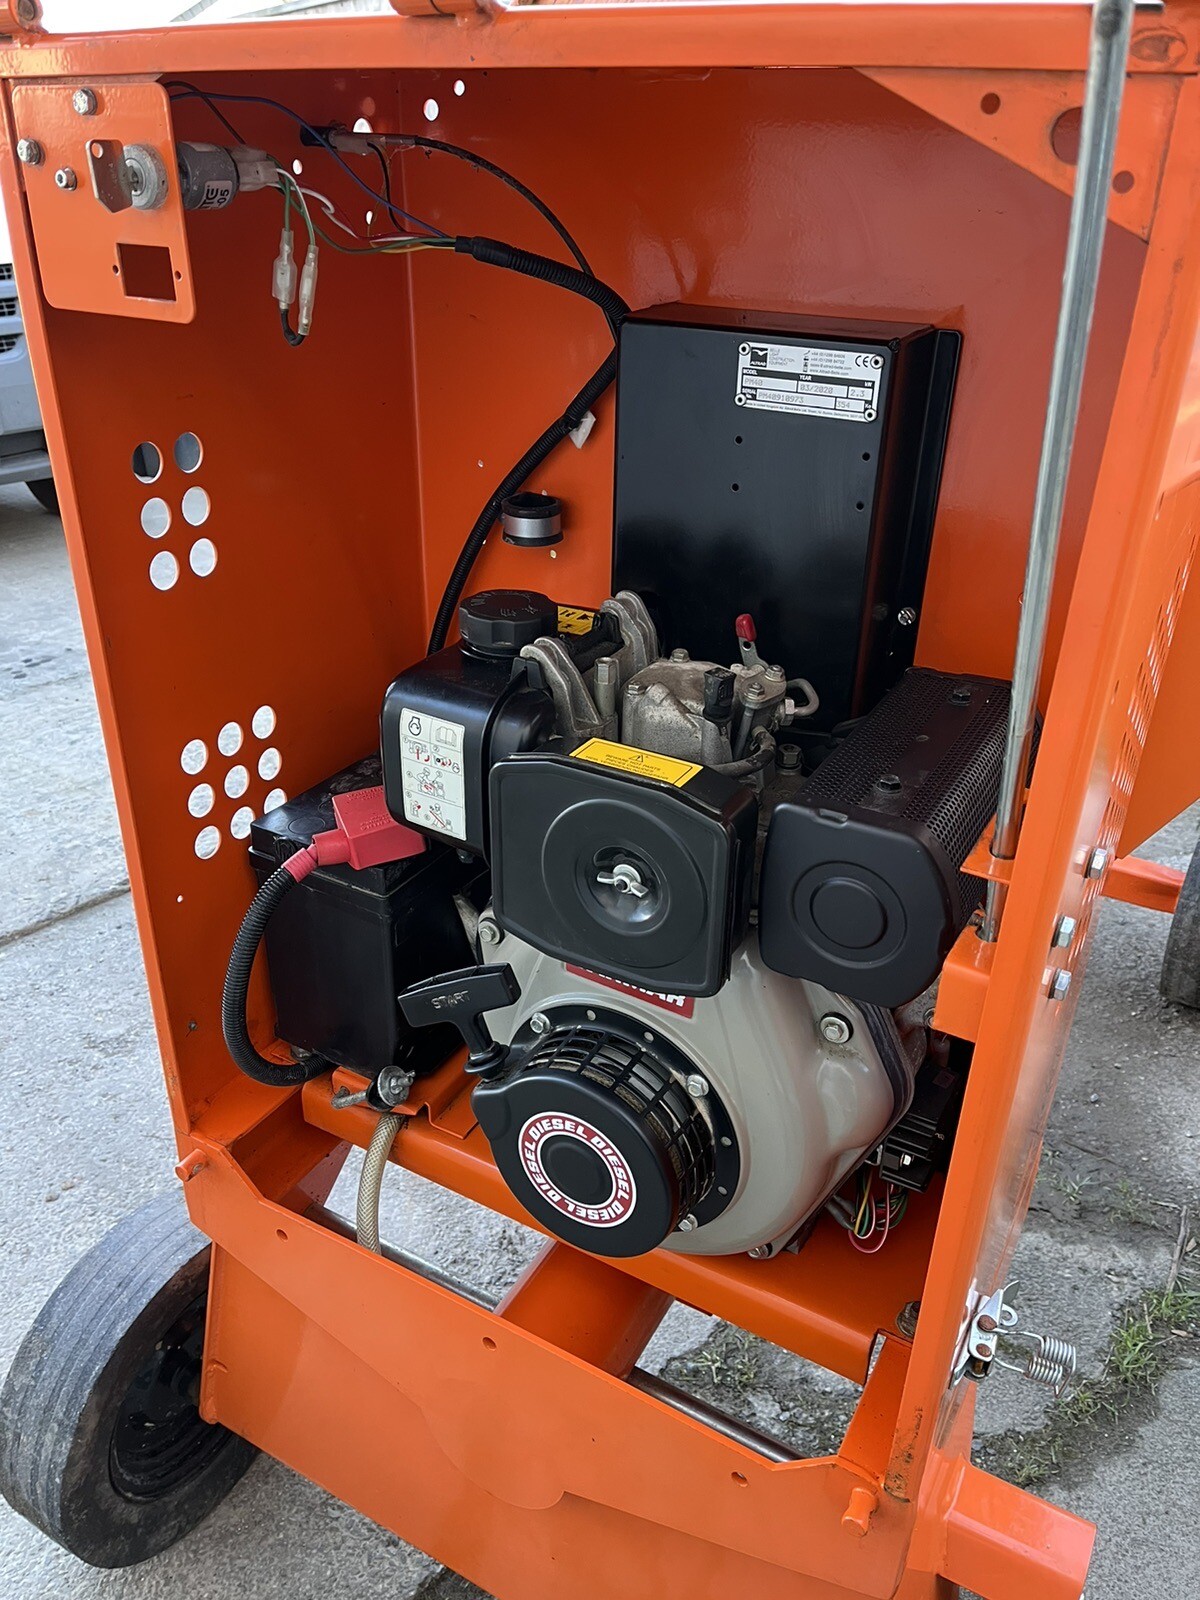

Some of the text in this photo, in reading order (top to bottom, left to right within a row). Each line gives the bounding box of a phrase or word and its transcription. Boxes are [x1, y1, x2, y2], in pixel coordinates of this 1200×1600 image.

[850, 389, 866, 398] 2.3
[836, 401, 851, 409] 354
[431, 990, 470, 1009] START
[528, 1118, 588, 1142] DIESEL
[524, 1140, 562, 1203] DIESEL
[590, 1135, 630, 1200] DIESEL
[564, 1200, 625, 1221] DIESEL
